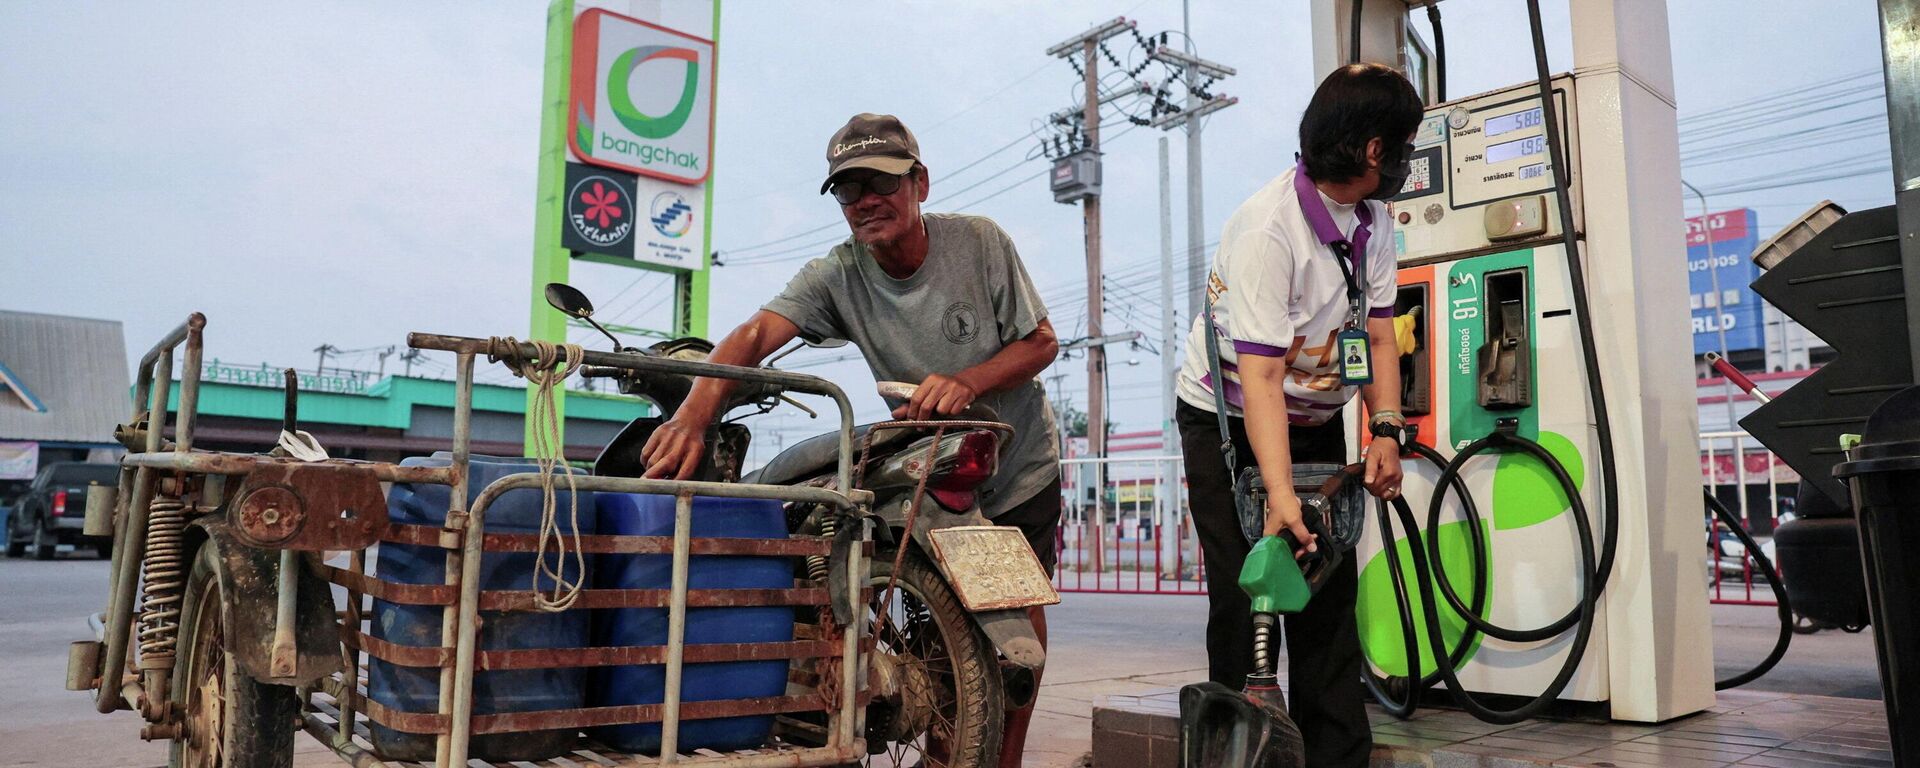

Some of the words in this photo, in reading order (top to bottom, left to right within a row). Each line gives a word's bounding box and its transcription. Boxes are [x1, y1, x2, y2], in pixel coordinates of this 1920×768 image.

[602, 131, 698, 170] bangchak
[833, 135, 887, 157] Champion
[573, 213, 629, 243] Inthanin
[1453, 297, 1478, 321] 91
